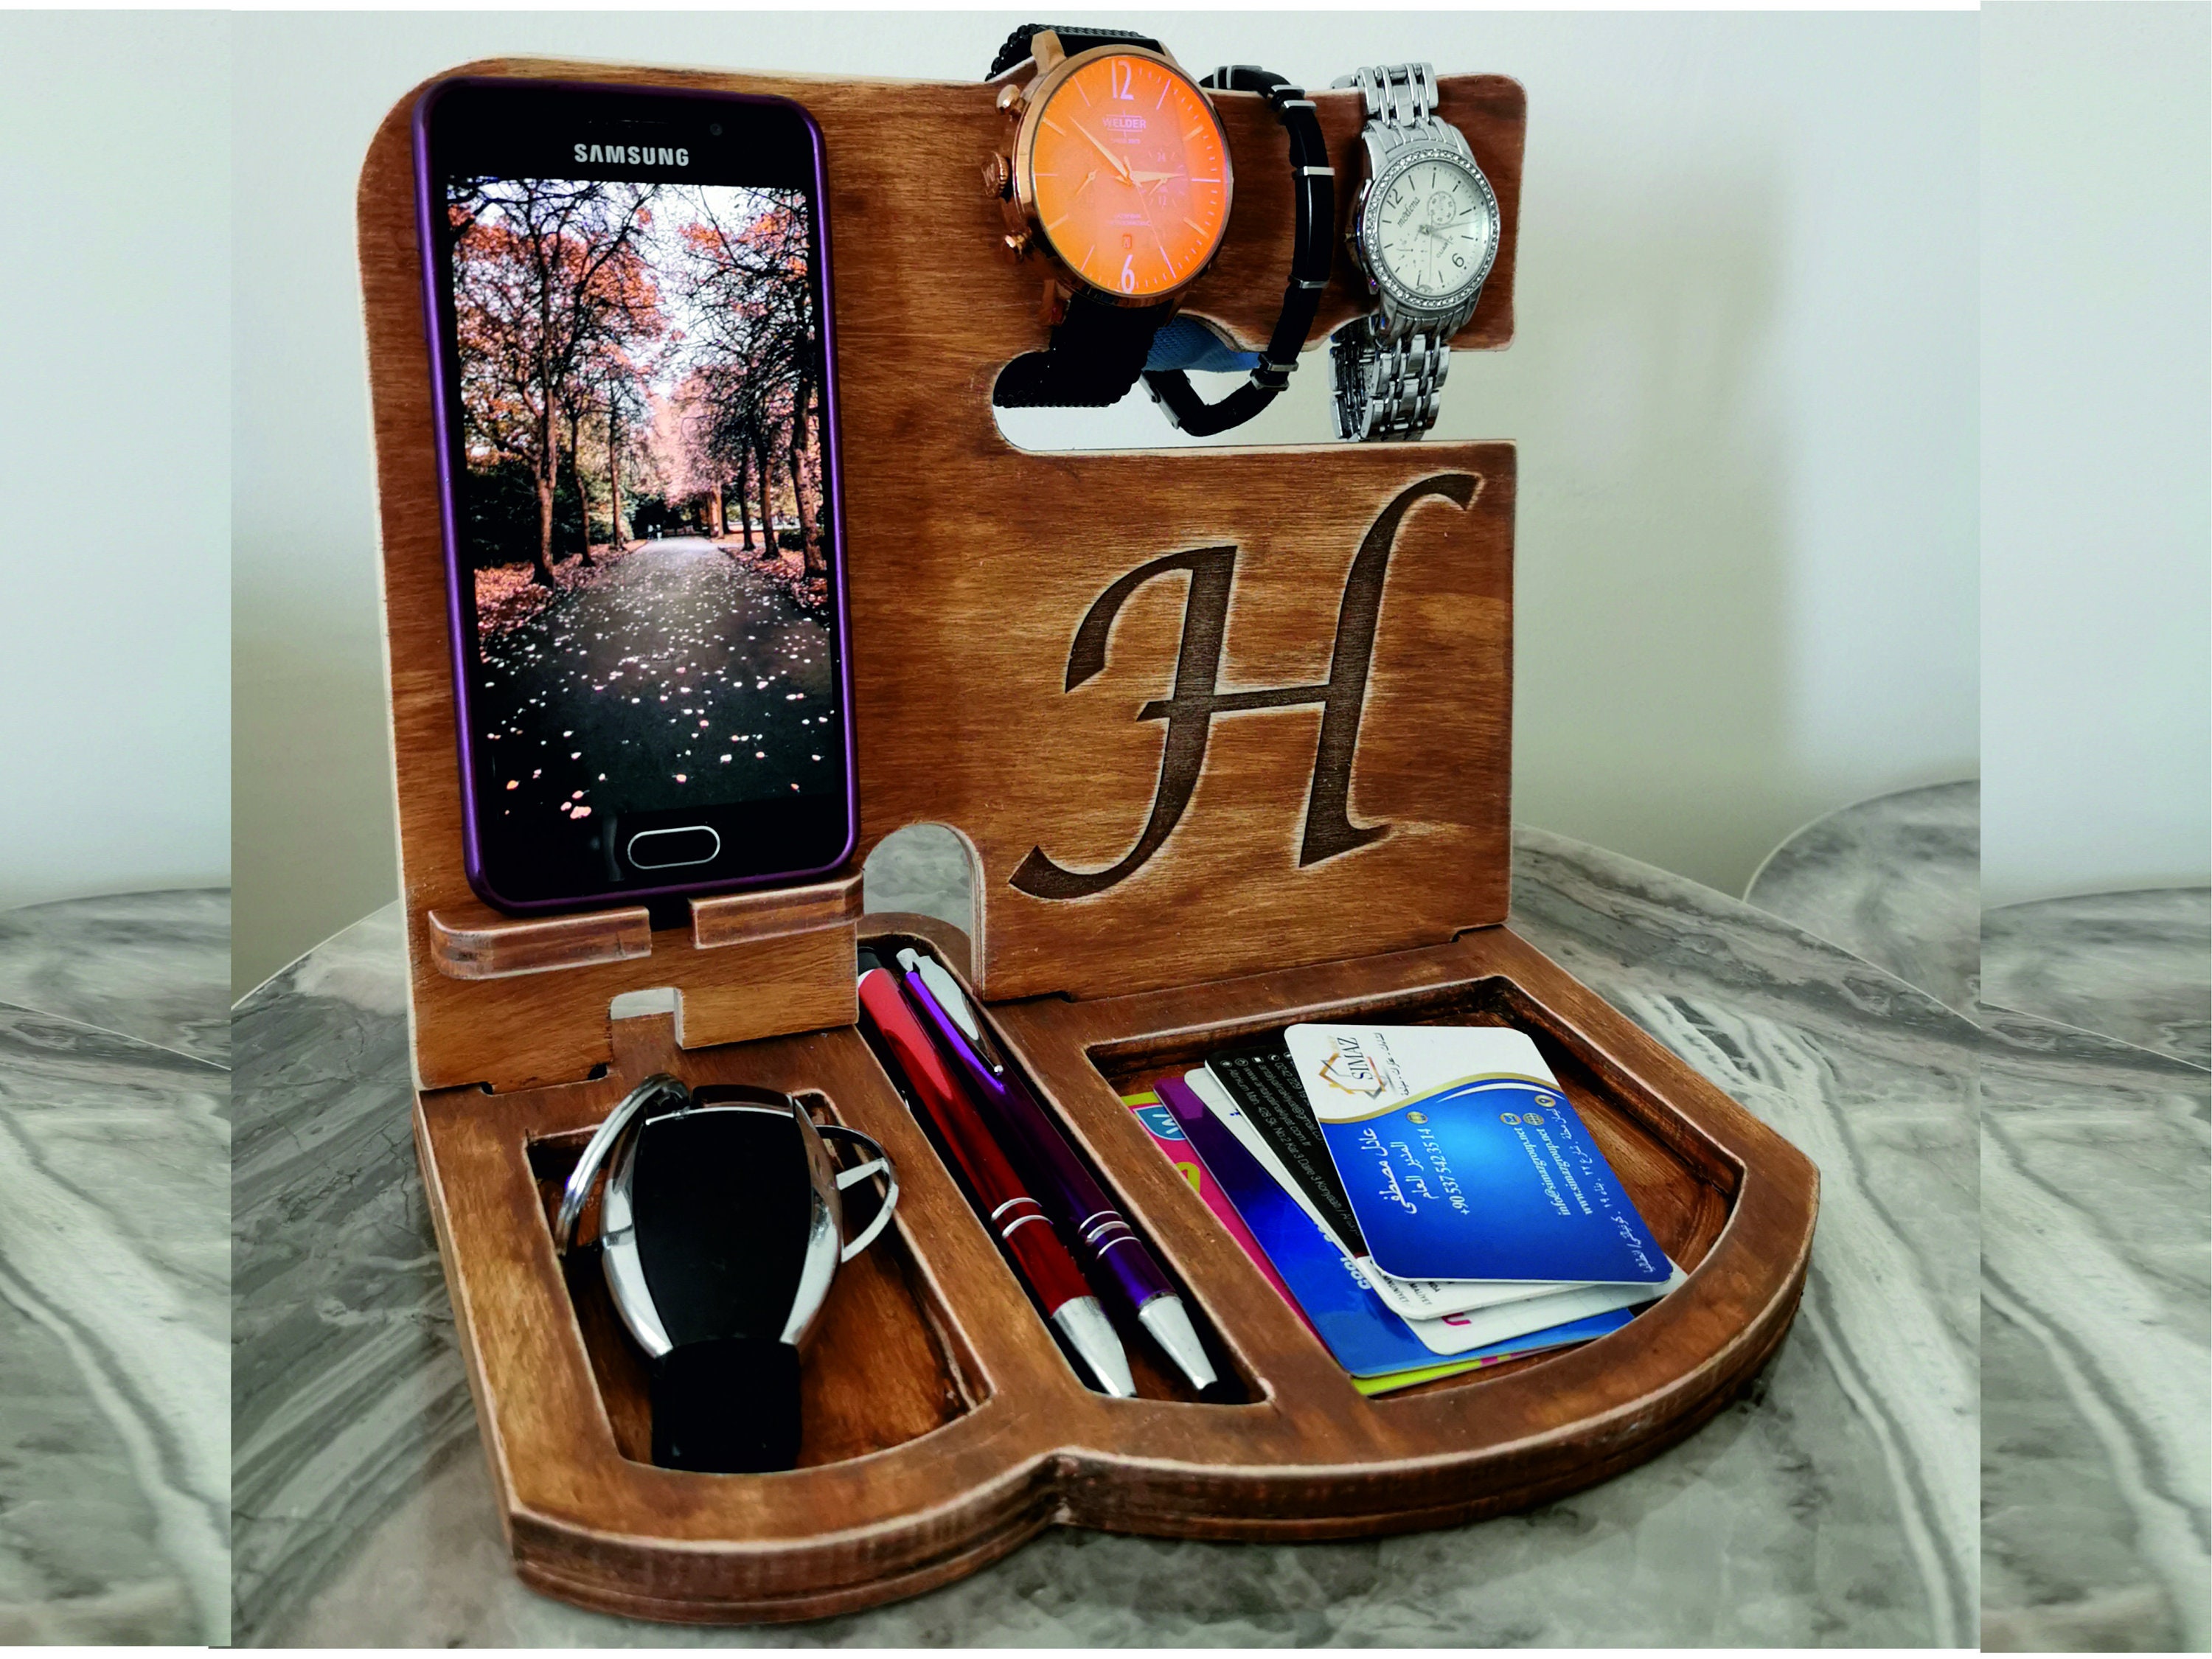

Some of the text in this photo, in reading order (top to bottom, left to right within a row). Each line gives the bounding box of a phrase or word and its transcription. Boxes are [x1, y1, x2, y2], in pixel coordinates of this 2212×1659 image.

[1112, 59, 1134, 100] 12
[1102, 118, 1146, 129] WELDER
[574, 143, 689, 167] SAMSUNG
[1386, 188, 1403, 209] 12
[1121, 254, 1135, 294] 6
[1452, 253, 1465, 268] 6
[1007, 472, 1482, 901] H
[1337, 1037, 1373, 1080] SIMAZ
[1358, 1127, 1388, 1157] عادل
[1405, 1175, 1440, 1199] العام
[1416, 1127, 1471, 1215] +90 537 542 35 14
[1514, 1127, 1571, 1217] info@simazgroup.net
[1536, 1127, 1593, 1216] www.simazgroup.net
